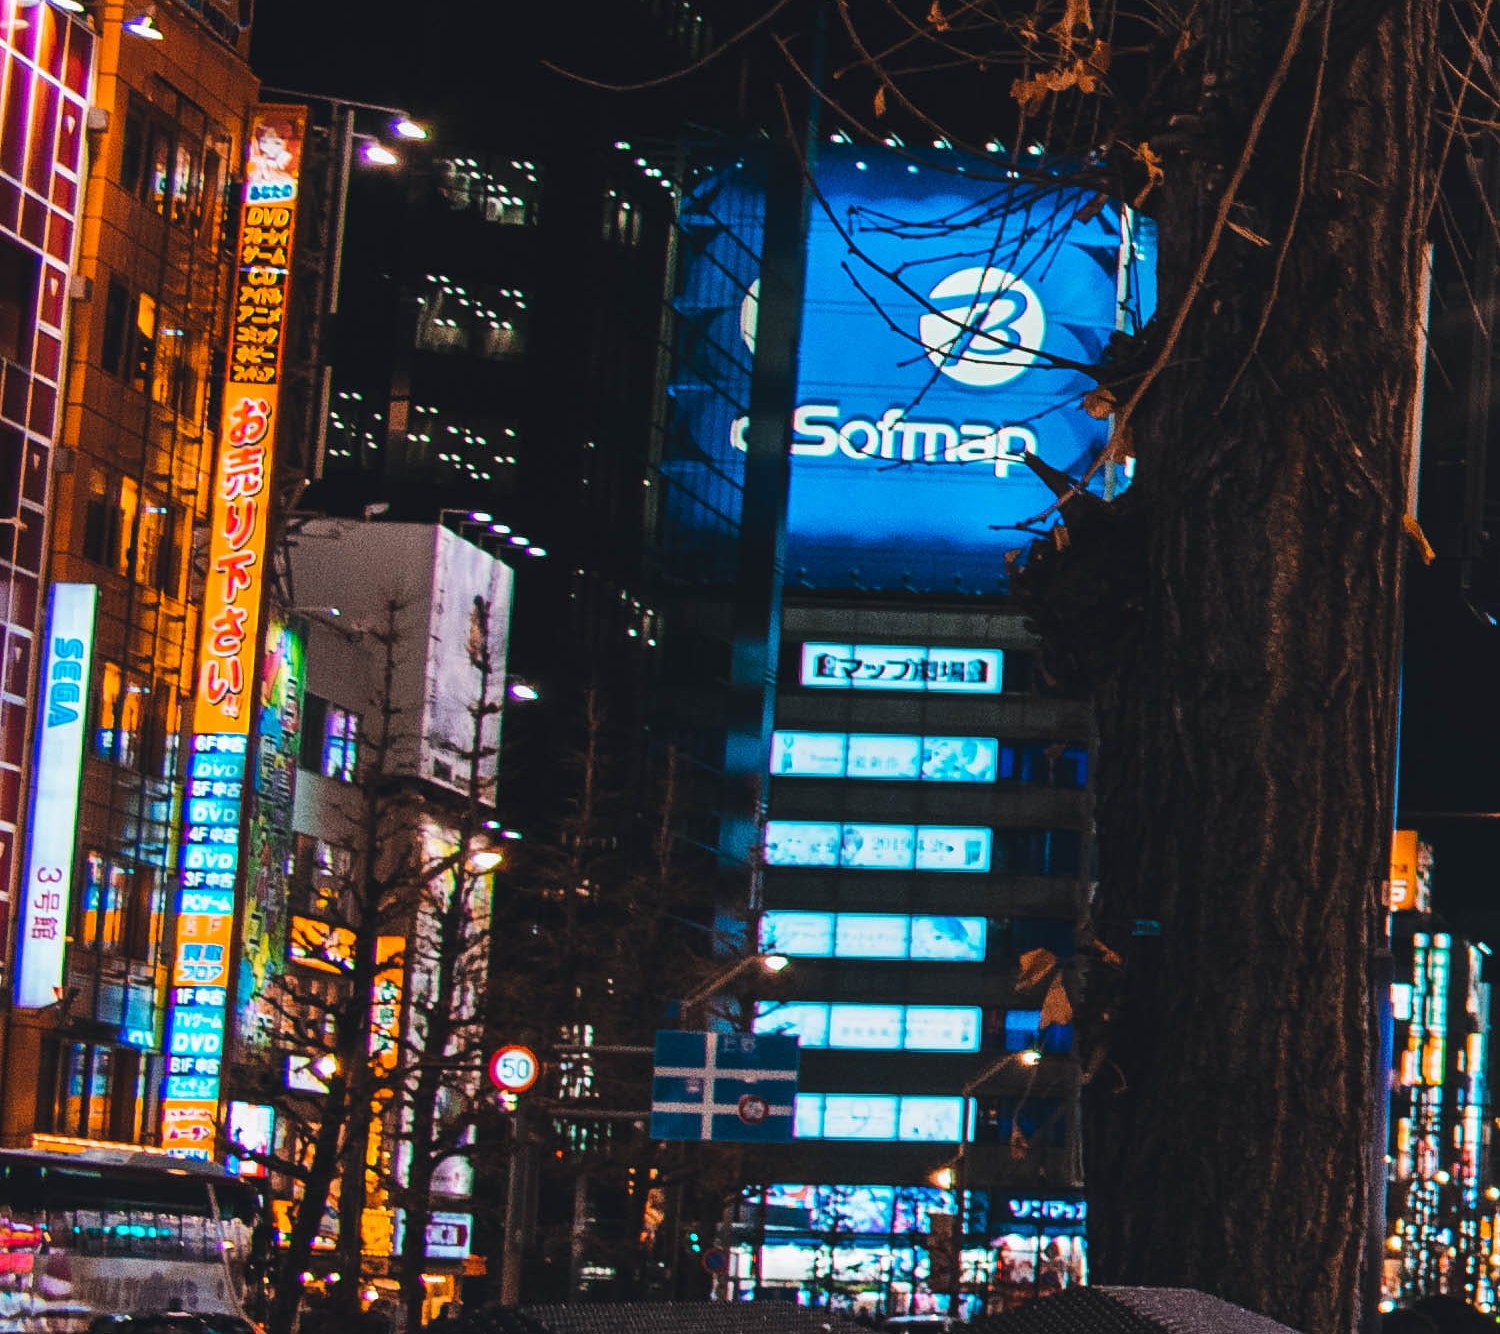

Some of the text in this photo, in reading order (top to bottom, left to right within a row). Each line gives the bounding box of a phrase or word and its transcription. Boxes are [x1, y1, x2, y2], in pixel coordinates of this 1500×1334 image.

[247, 207, 290, 226] DVD
[792, 405, 1037, 478] Sofmap
[48, 636, 84, 729] SEGA
[197, 763, 238, 777] DVD
[192, 807, 237, 822] DVD
[189, 854, 233, 868] DVD
[31, 866, 63, 940] 3号館
[174, 1033, 219, 1053] DVD
